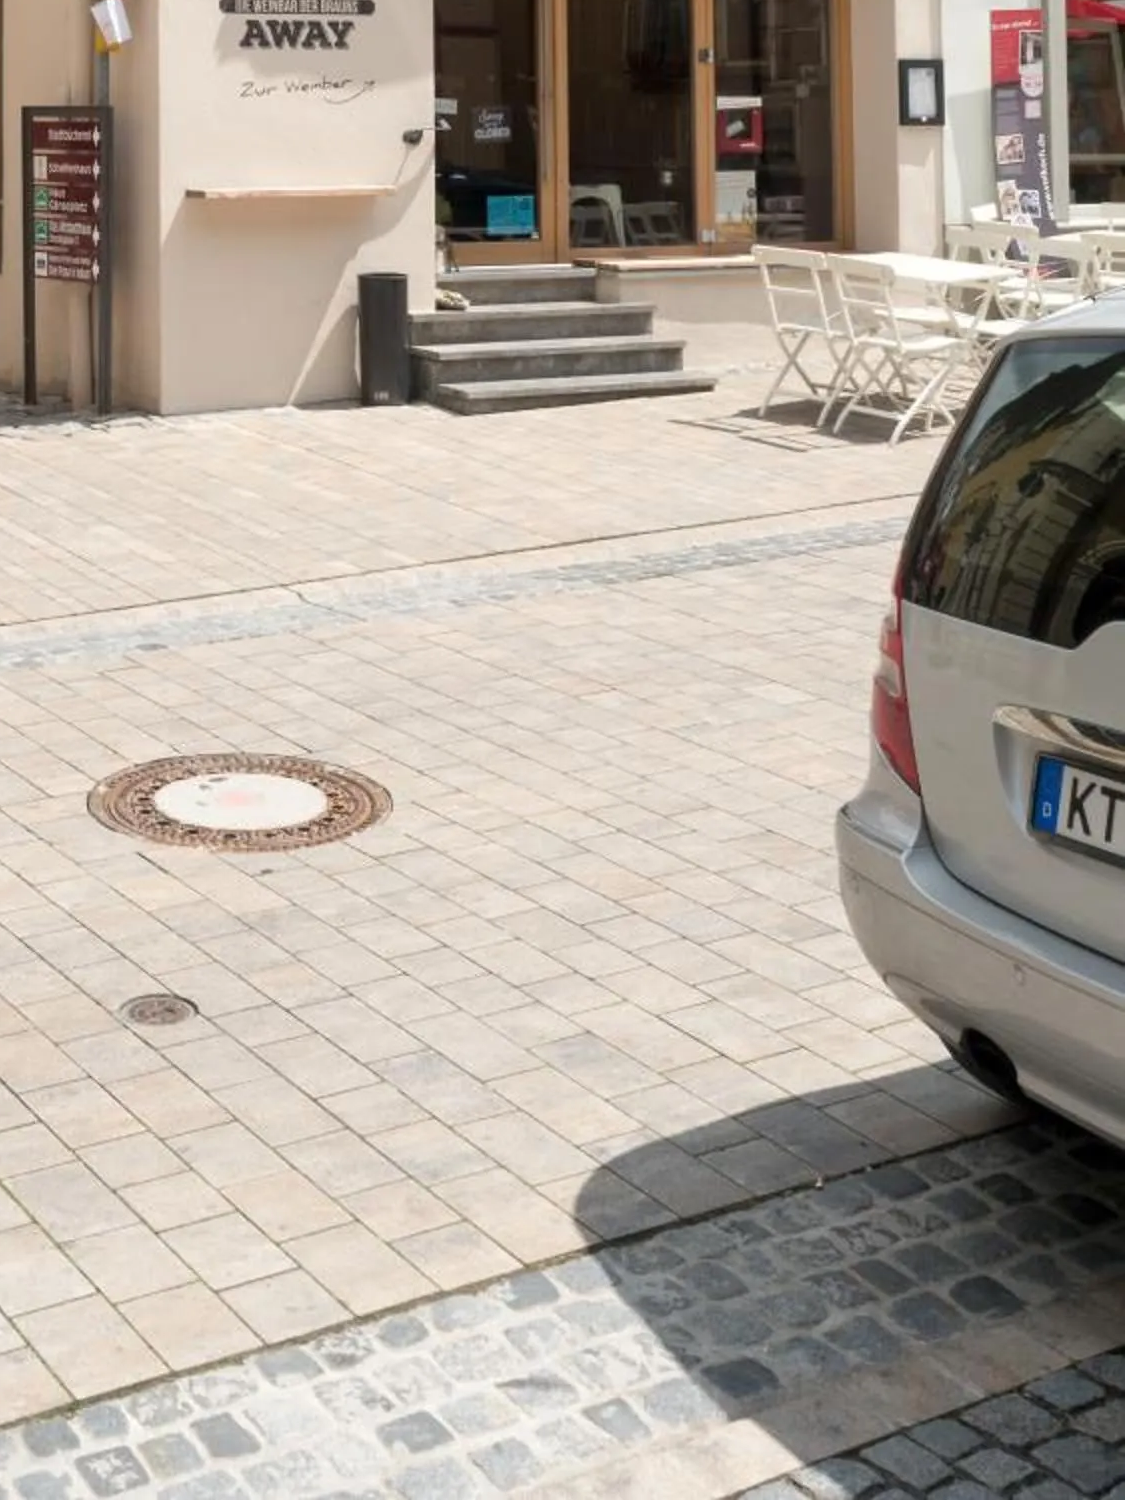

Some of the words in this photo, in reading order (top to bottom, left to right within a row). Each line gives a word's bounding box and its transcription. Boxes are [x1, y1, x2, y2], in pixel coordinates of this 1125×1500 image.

[239, 19, 355, 50] AWAY
[239, 80, 278, 98] Zur
[1042, 802, 1052, 817] D
[1067, 777, 1125, 842] KT
